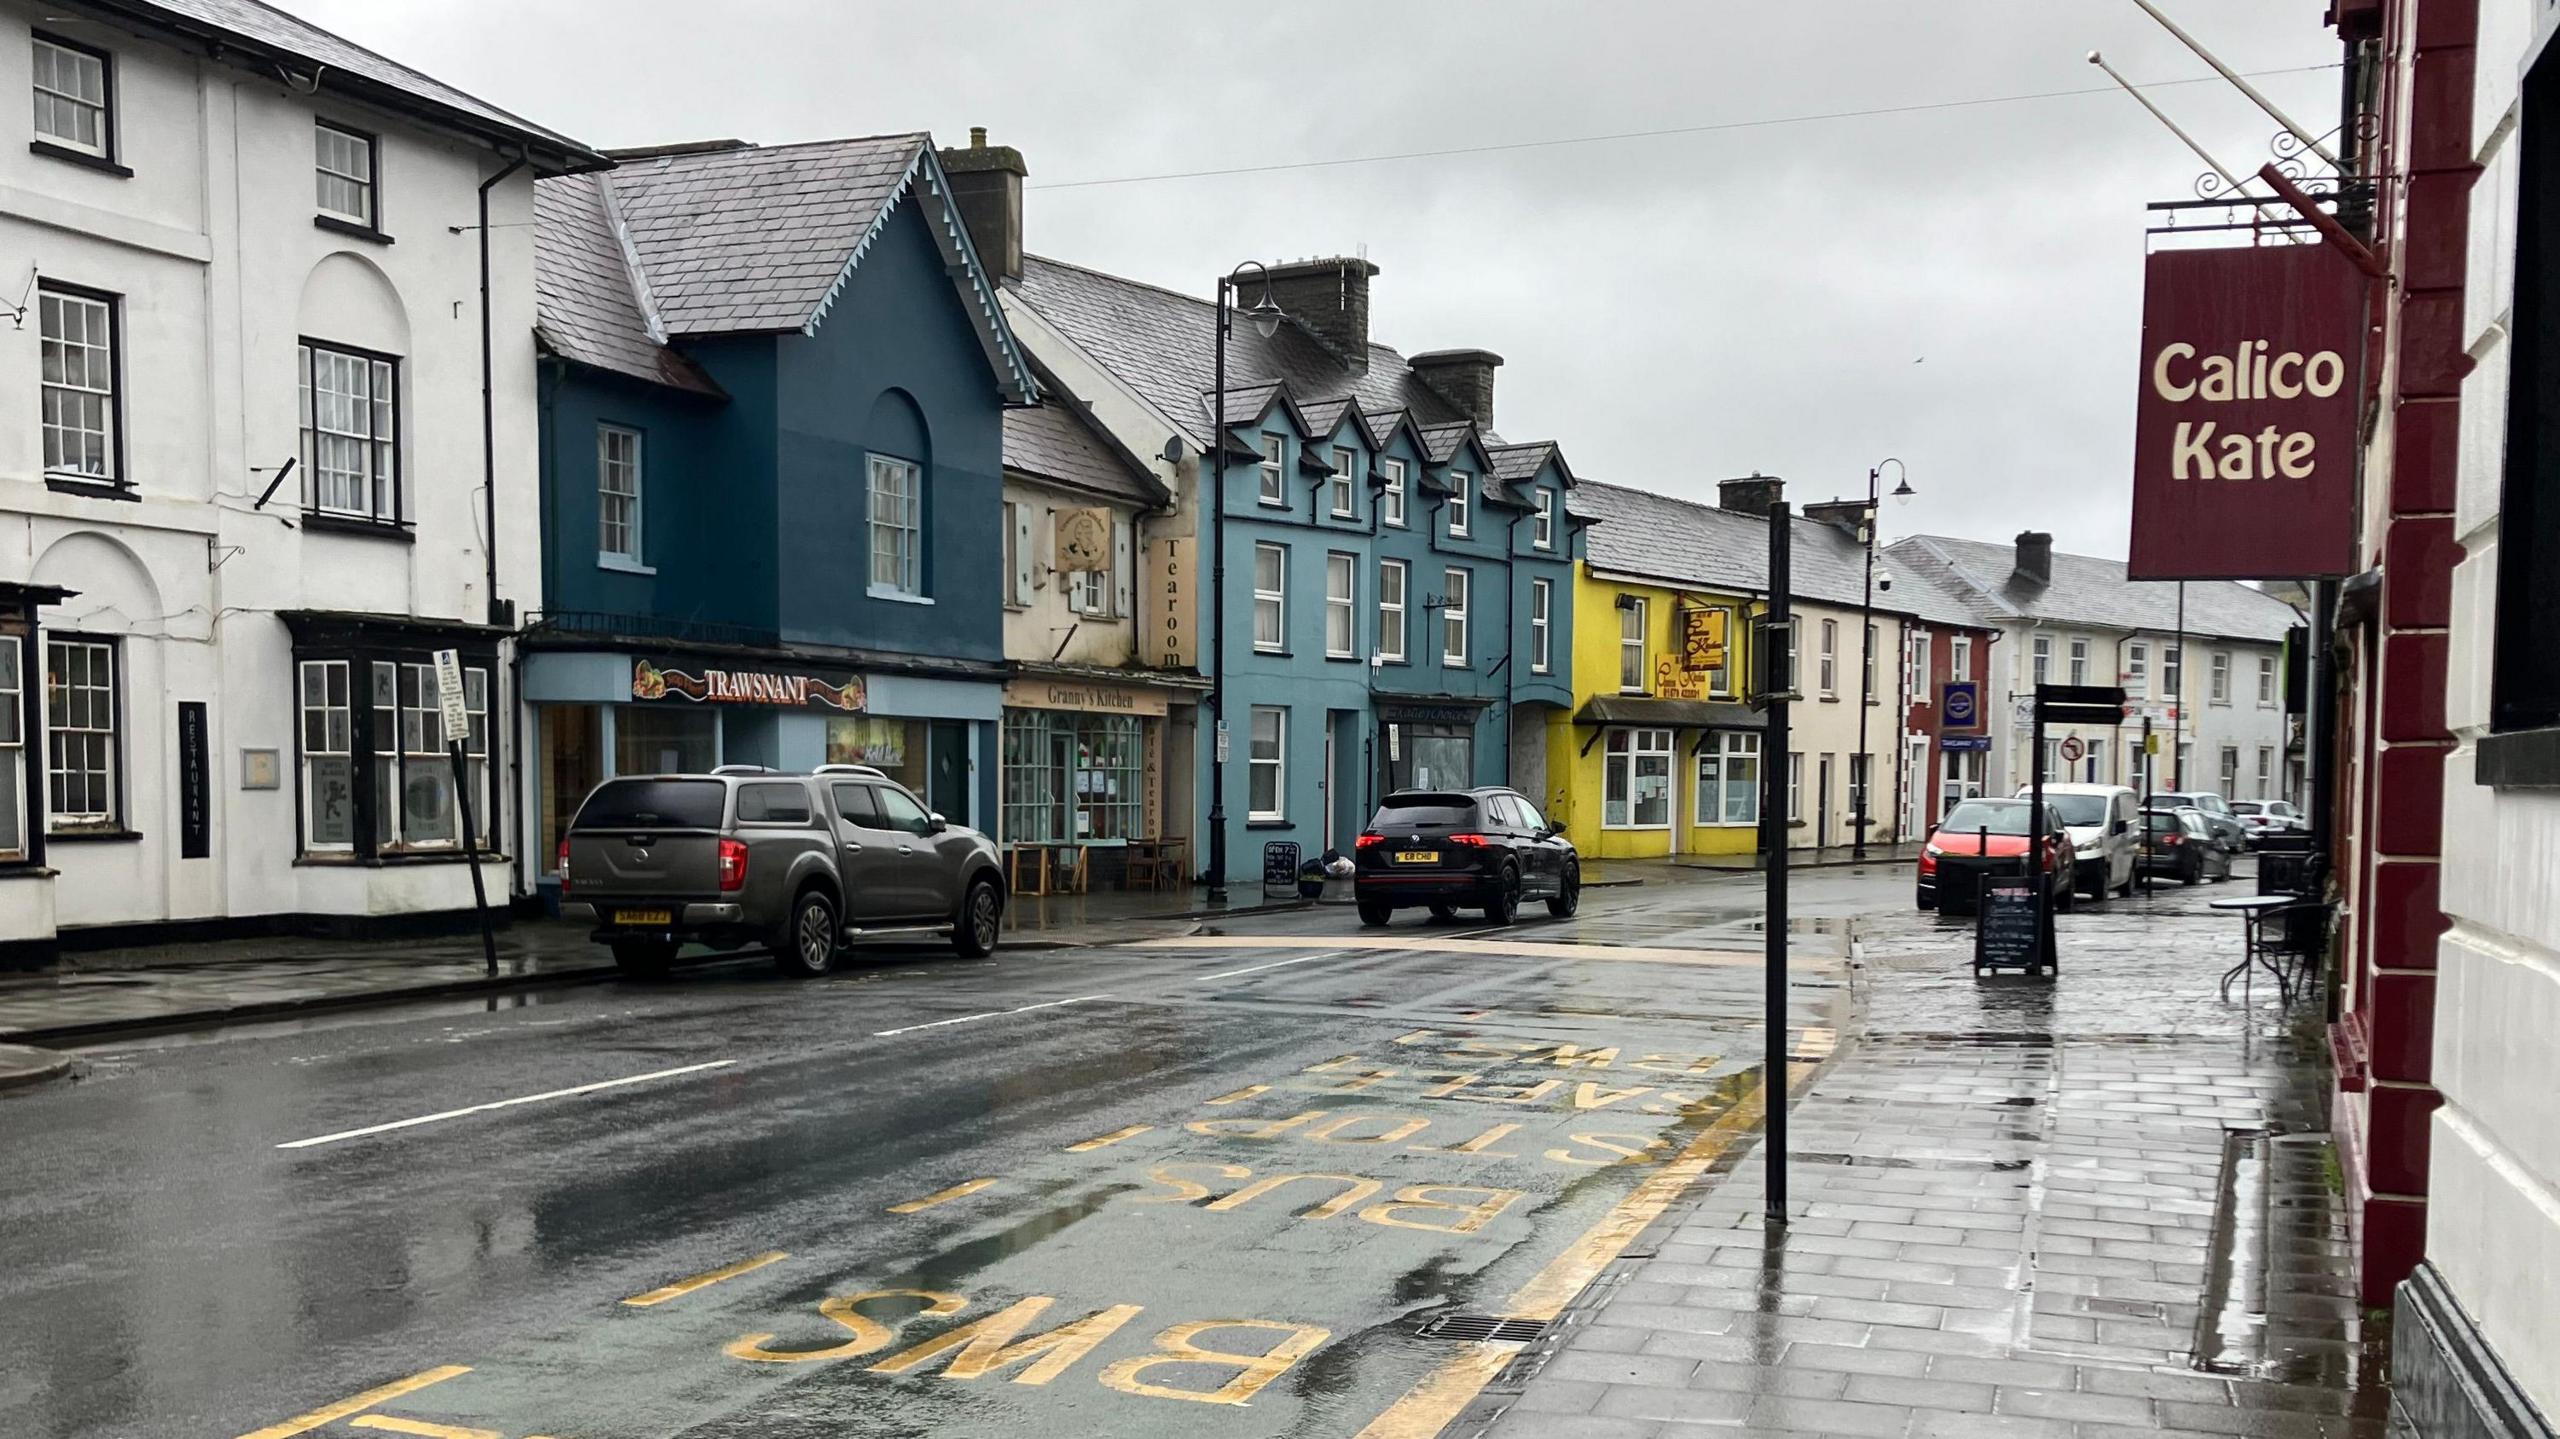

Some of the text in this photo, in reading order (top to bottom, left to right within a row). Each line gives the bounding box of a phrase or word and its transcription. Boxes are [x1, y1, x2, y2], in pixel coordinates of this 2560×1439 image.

[2153, 339, 2346, 402] Calico
[2172, 421, 2317, 481] Kate
[1164, 539, 1181, 667] Tearoom
[704, 669, 808, 702] TRAWSNANT
[1047, 686, 1095, 709] Granny's
[1096, 688, 1134, 709] Kitchen
[188, 709, 201, 835] RESTAURANT
[1186, 1110, 1673, 1167] STOP
[1136, 1162, 1528, 1234] BUS
[722, 1288, 1334, 1406] BWS
